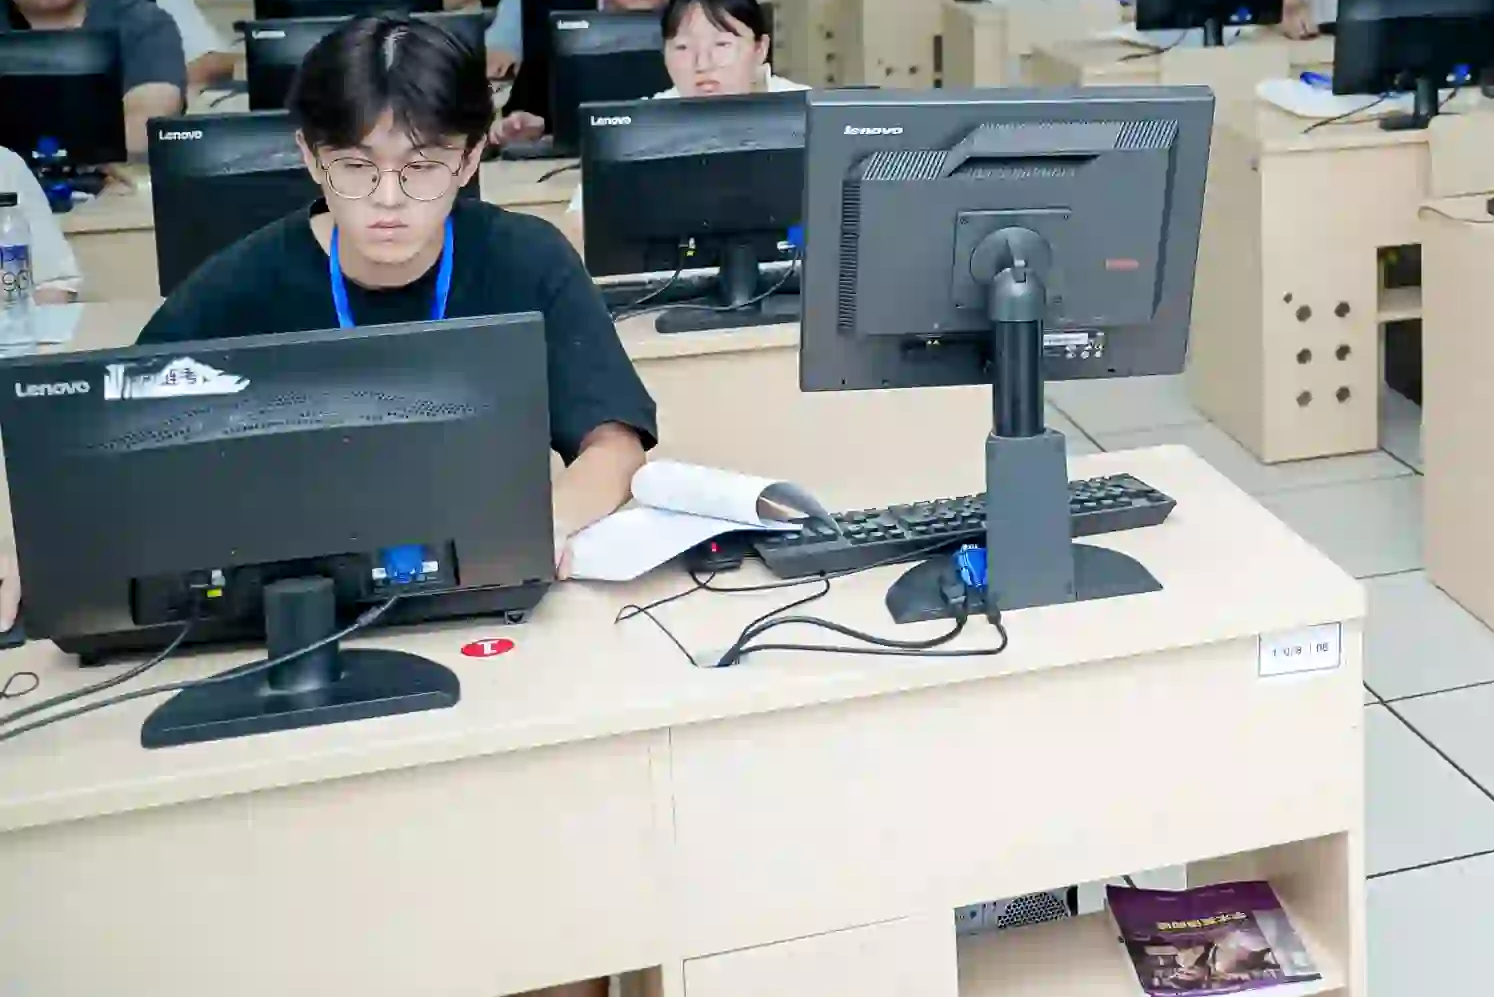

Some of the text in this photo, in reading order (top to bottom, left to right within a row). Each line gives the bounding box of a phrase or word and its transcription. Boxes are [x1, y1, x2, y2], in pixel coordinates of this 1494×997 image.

[590, 115, 632, 126] Lenovo
[159, 130, 203, 141] Lenovo
[844, 124, 904, 136] lenovo
[15, 379, 91, 398] Lenovo
